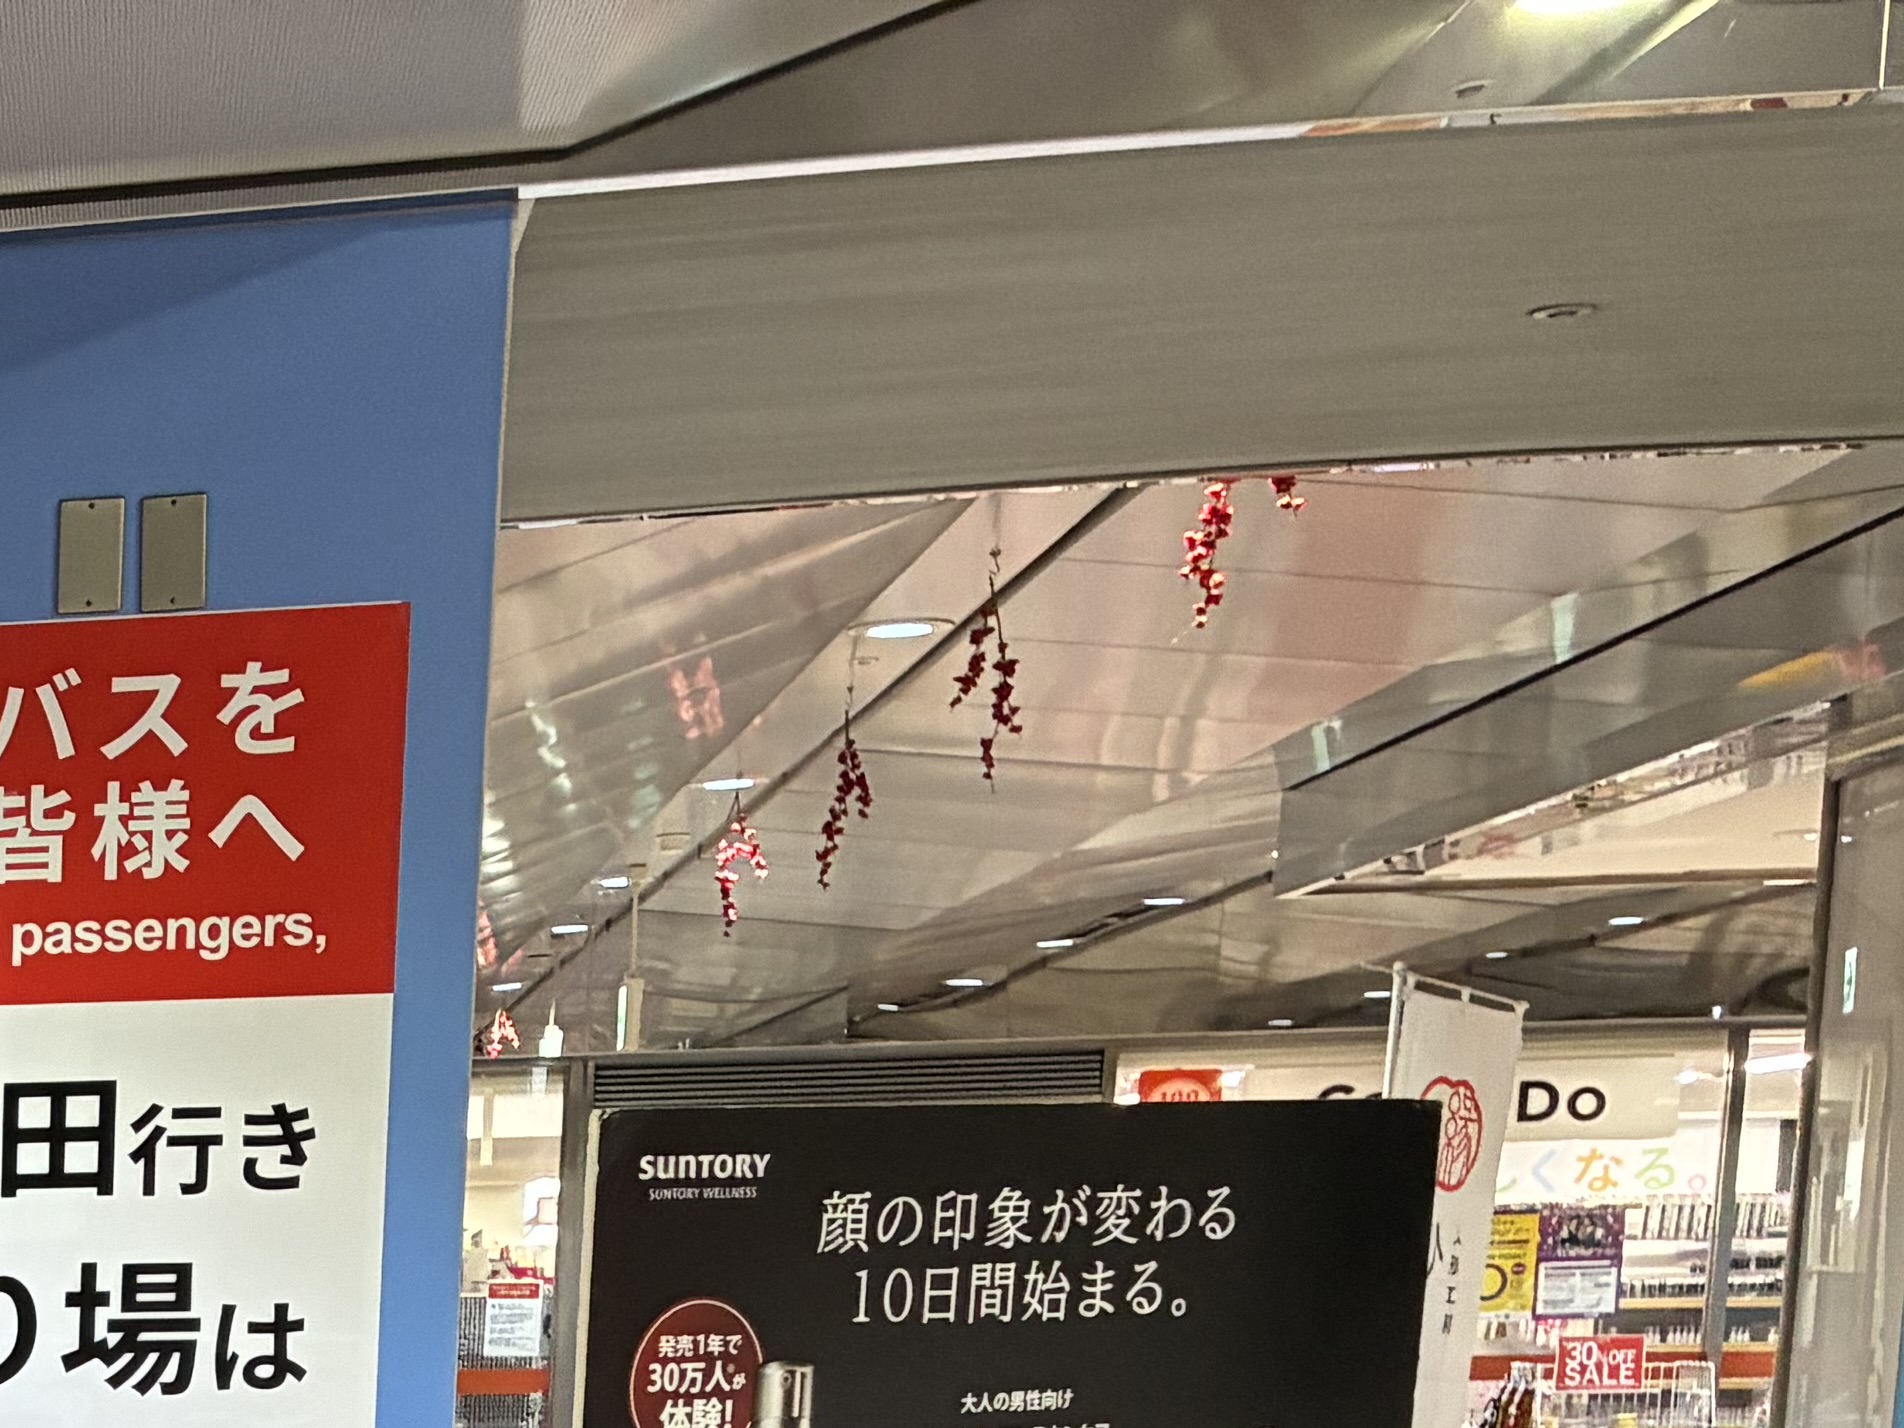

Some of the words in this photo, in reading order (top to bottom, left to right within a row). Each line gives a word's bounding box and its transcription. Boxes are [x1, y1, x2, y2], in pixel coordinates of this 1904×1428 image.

[12, 912, 328, 965] passengers,
[638, 1152, 771, 1181] SUNTORY
[816, 1183, 1239, 1257] 顔の印象が変わる
[850, 1258, 1190, 1328] 10日間始まる。
[657, 1333, 743, 1357] 発売1年で
[1565, 1363, 1636, 1386] SALE
[960, 1388, 1074, 1415] 大人の男性向け
